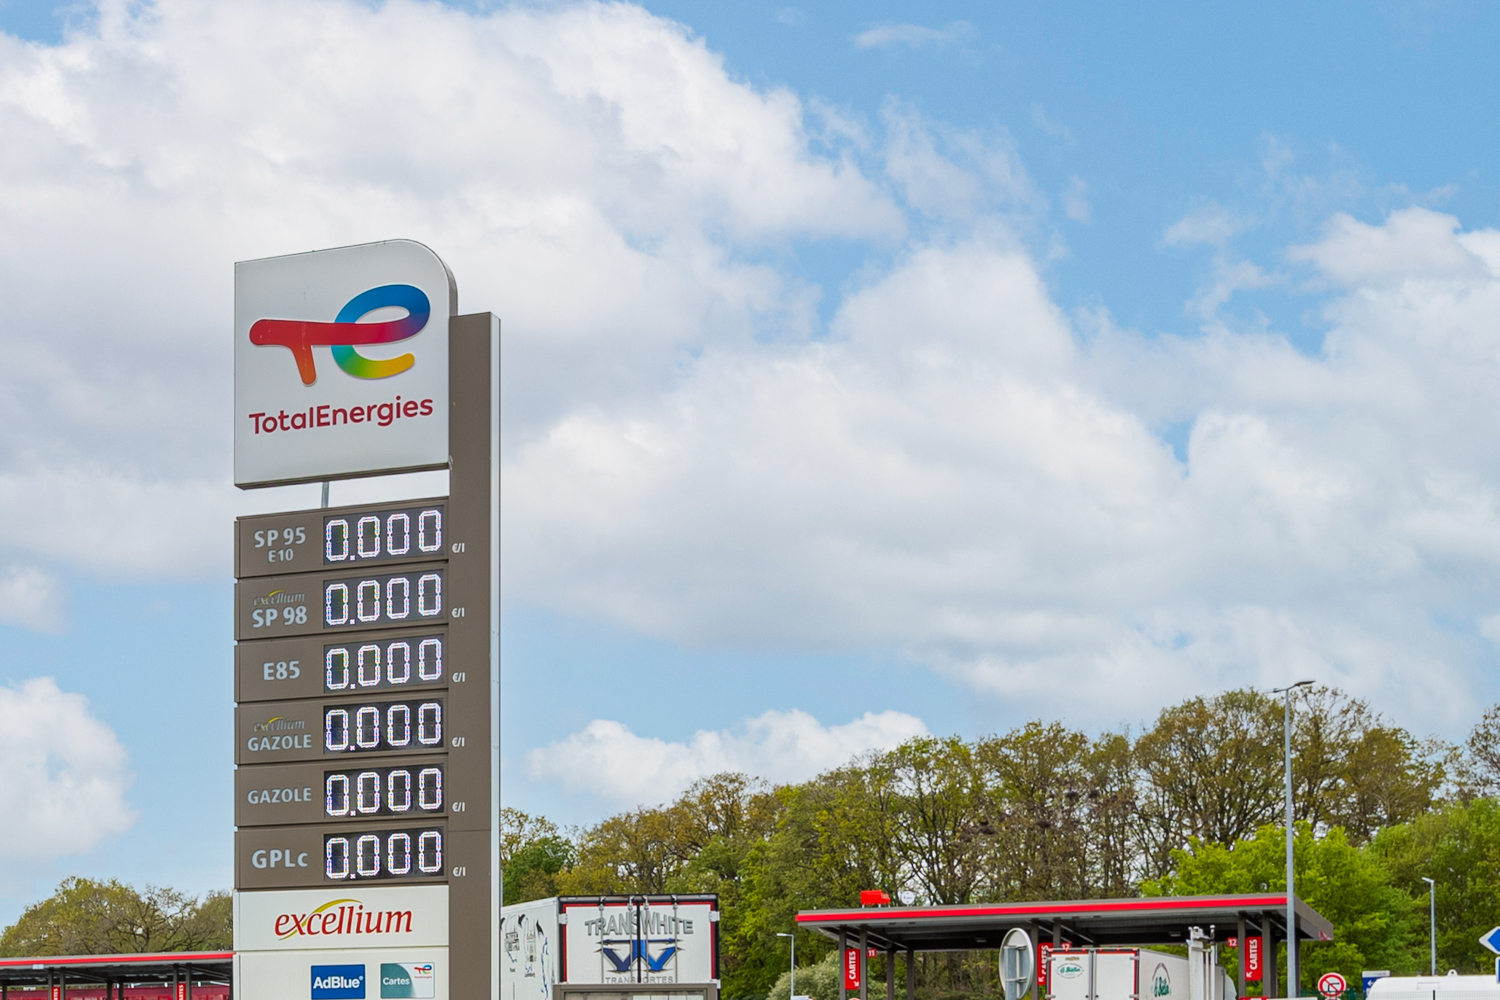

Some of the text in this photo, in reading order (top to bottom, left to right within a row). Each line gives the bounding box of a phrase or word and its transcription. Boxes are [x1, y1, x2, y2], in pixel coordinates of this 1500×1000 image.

[249, 395, 433, 435] TotalEnergies
[253, 526, 306, 549] SP 95
[325, 509, 442, 562] 0.000
[267, 548, 294, 563] E10
[253, 590, 305, 607] excellium
[325, 573, 442, 625] 0.000
[251, 605, 308, 629] SP 98
[263, 660, 301, 681] E85
[325, 638, 442, 690] 0.000
[253, 716, 305, 733] excellium
[325, 702, 442, 751] 0.000
[247, 734, 312, 752] GAZOLE
[247, 787, 312, 805] GAZOLE
[325, 767, 442, 817] 0.000
[251, 848, 308, 869] GPLc
[325, 831, 442, 879] 0.000
[274, 903, 413, 937] excellium
[1228, 938, 1237, 946] 12
[848, 950, 856, 980] CARTES
[1249, 938, 1258, 971] CARTES
[383, 976, 411, 986] Cartes
[605, 976, 674, 984] TRANSORTES
